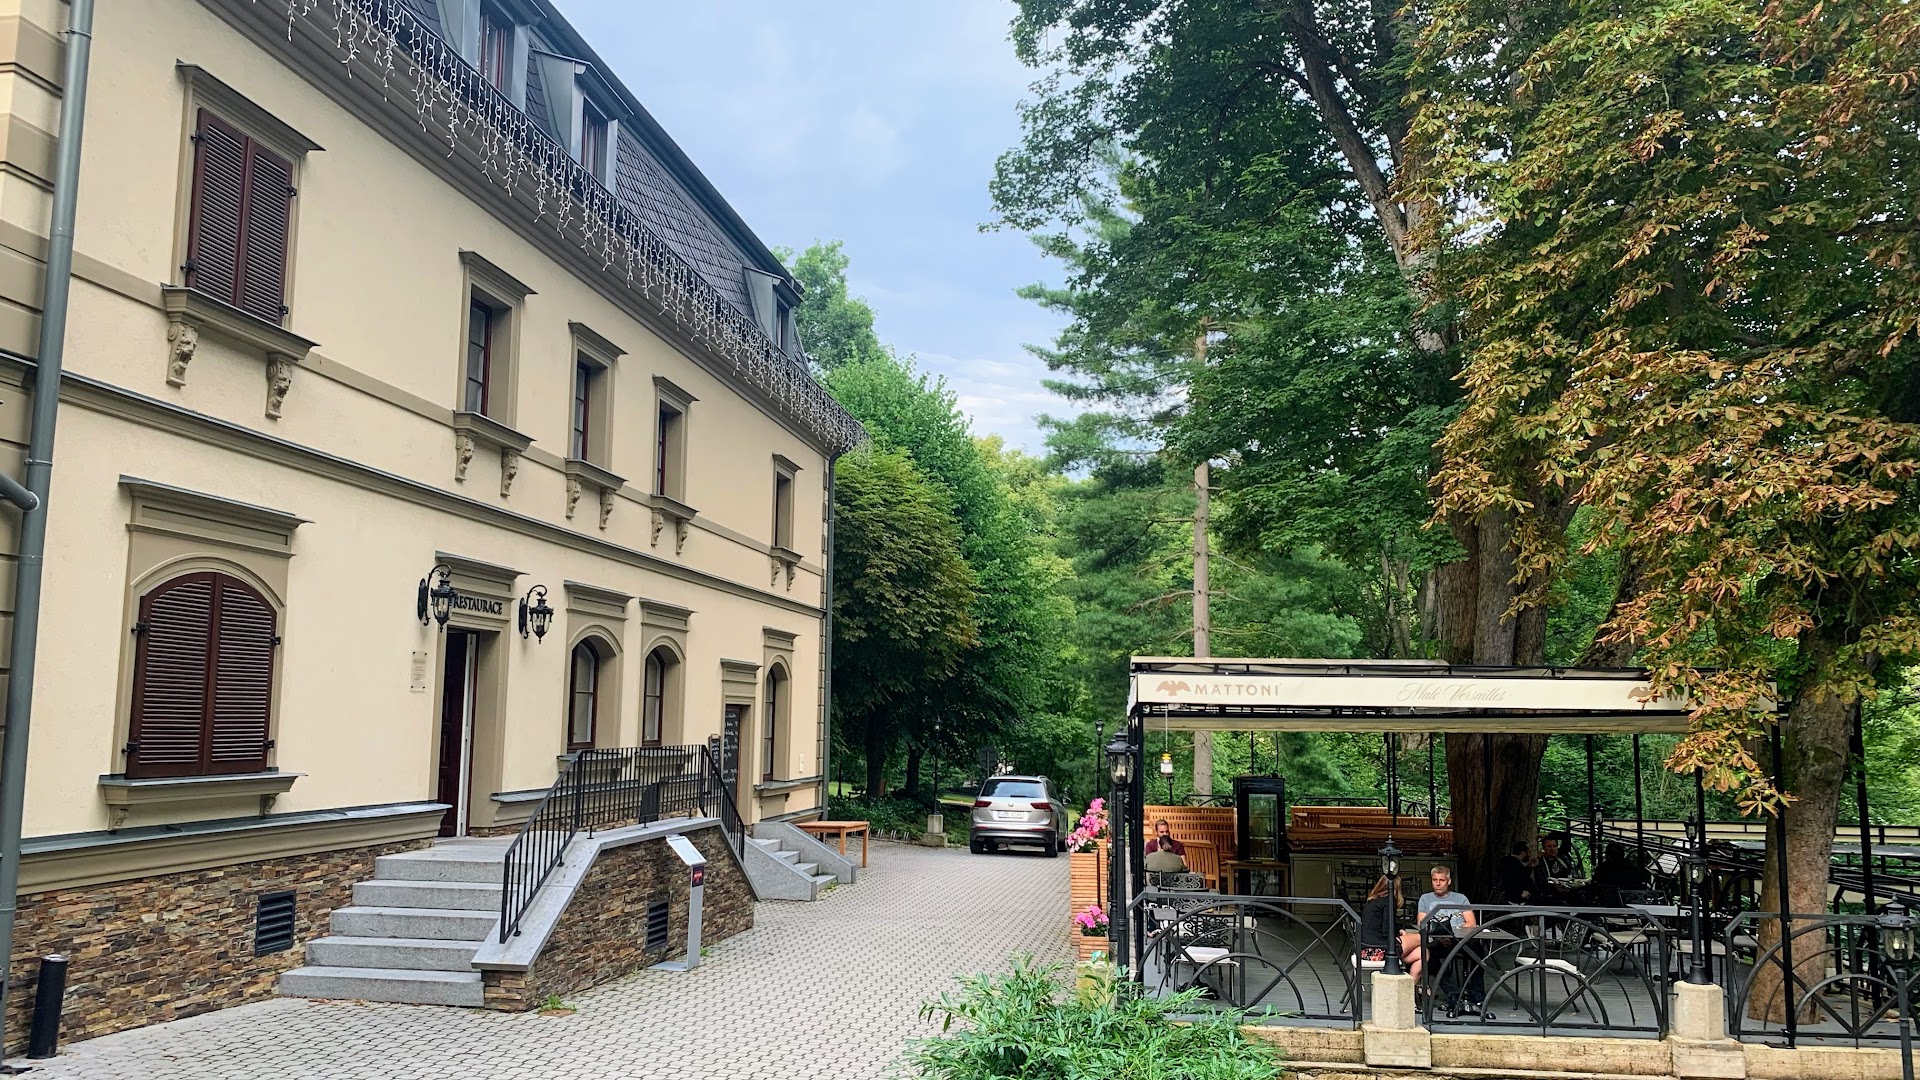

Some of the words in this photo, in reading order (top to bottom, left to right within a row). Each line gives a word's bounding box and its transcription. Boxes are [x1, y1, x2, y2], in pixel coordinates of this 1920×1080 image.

[453, 595, 503, 615] RESTAURACE
[1194, 683, 1279, 696] MATTONI
[1443, 683, 1507, 702] Versailles
